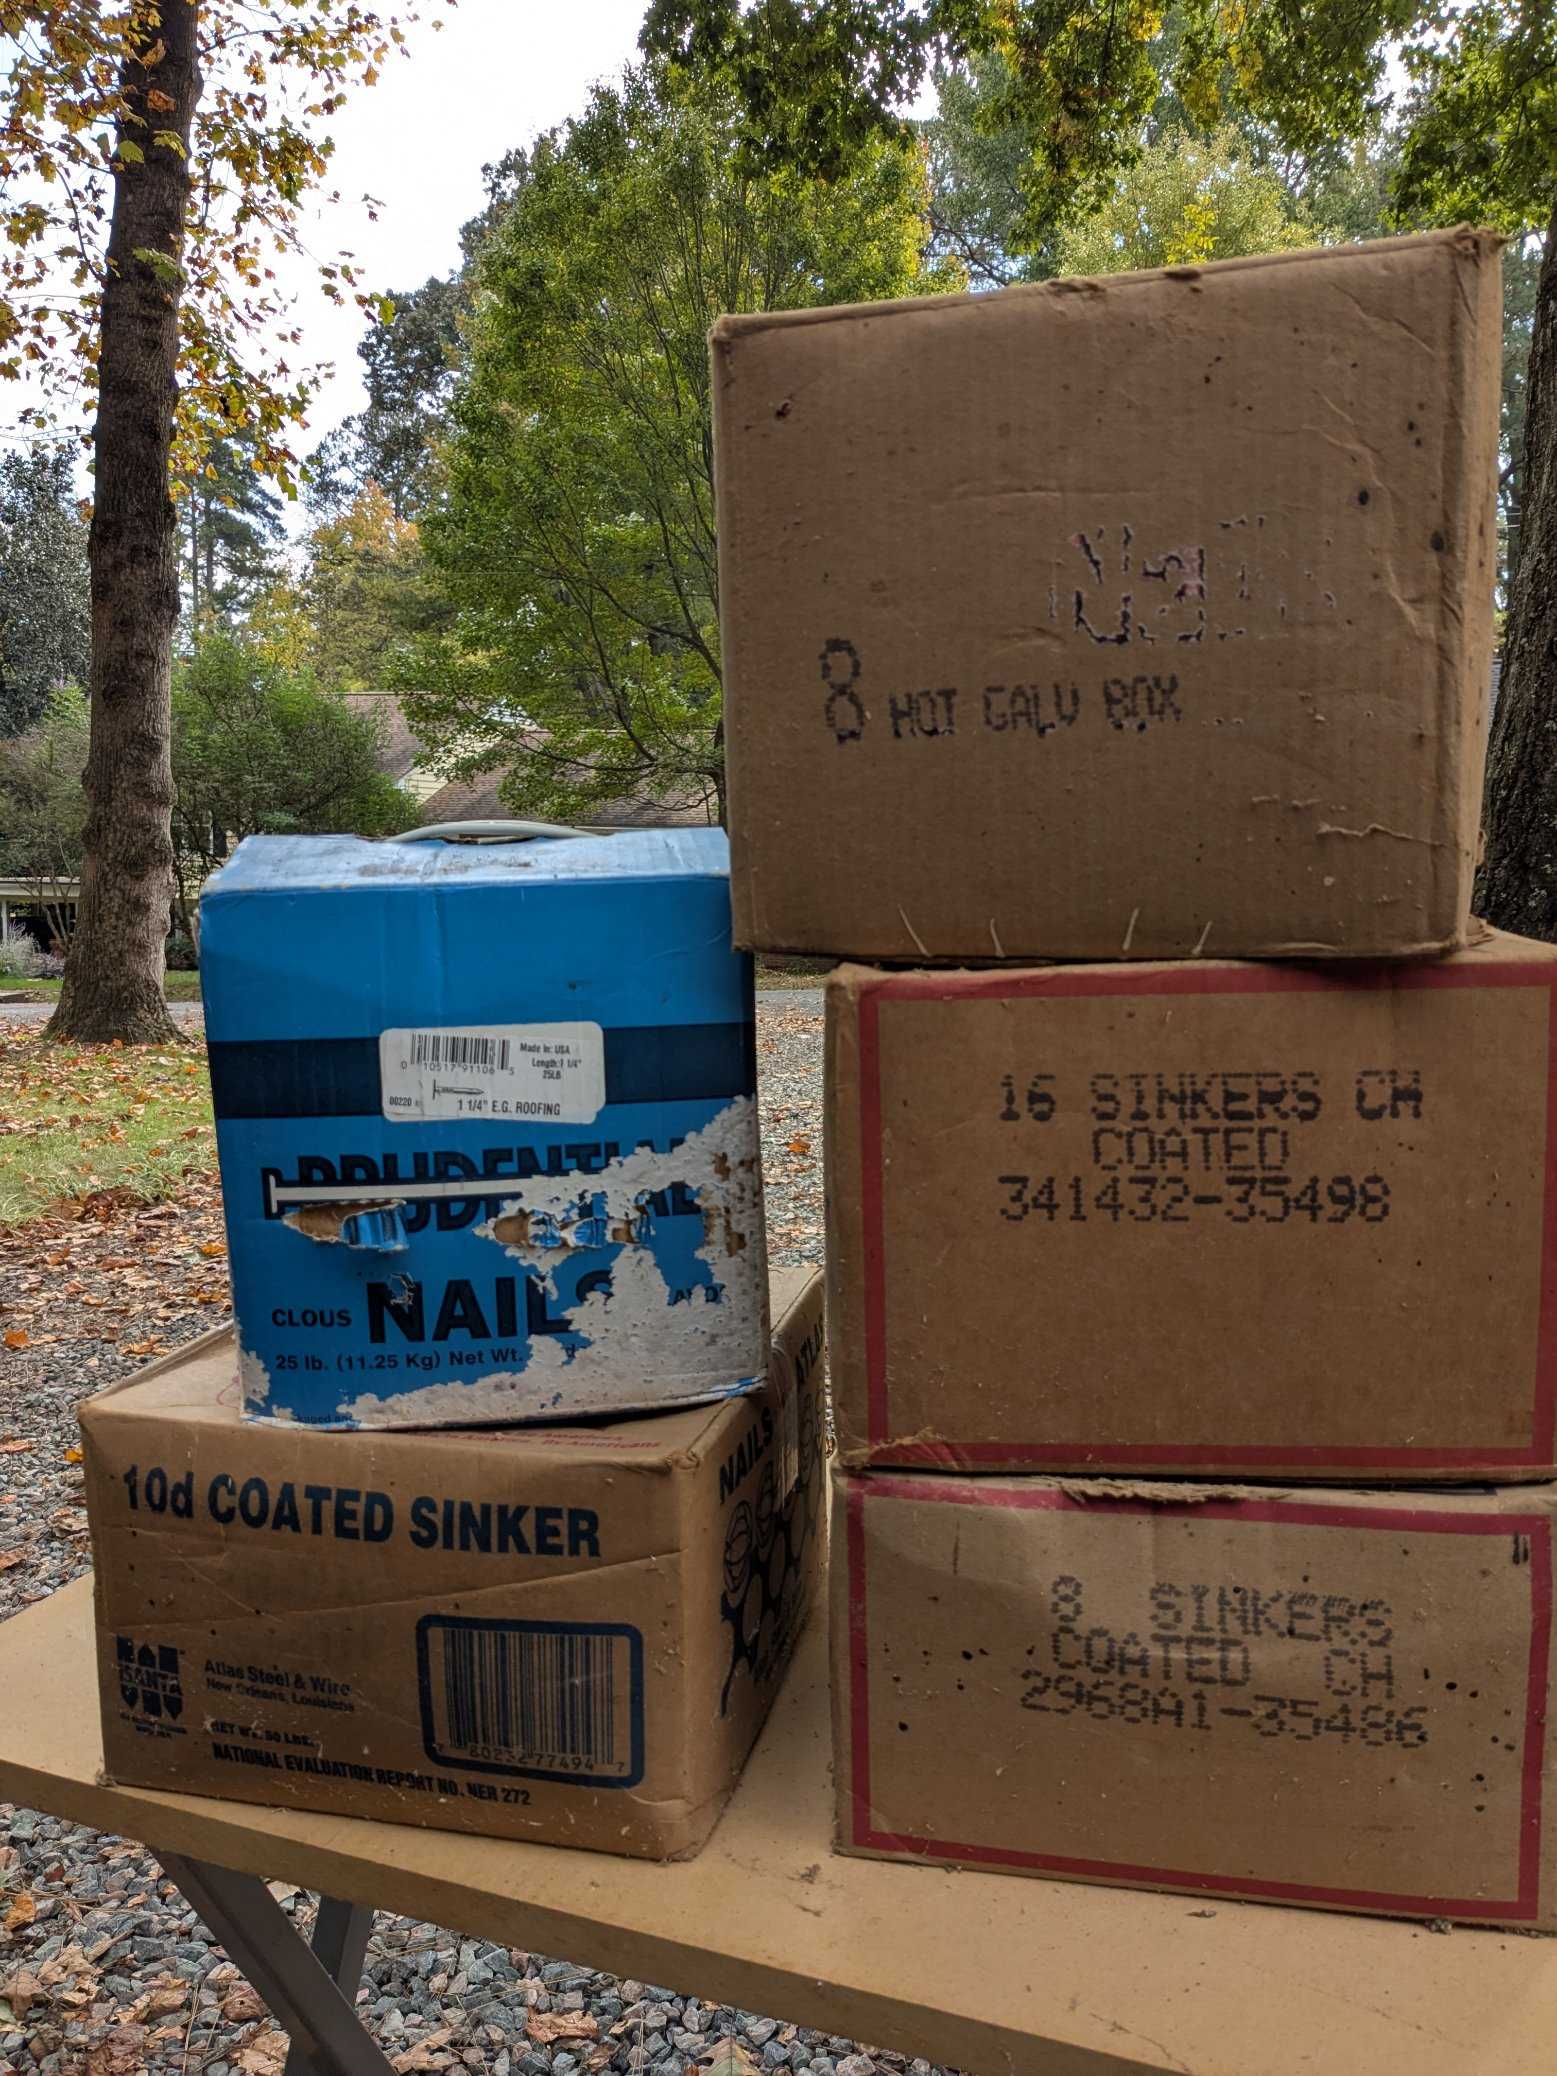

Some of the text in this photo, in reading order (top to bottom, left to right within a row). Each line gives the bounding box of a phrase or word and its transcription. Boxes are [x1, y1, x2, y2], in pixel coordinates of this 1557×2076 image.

[819, 637, 1183, 744] 8 HOT GALV BOX
[520, 1043, 541, 1052] Made
[492, 1101, 512, 1114] E.G.
[516, 1102, 560, 1116] ROOFING
[1000, 1074, 1056, 1121] 16
[1091, 1072, 1322, 1122] SINKERS
[1092, 1127, 1290, 1171] COATED
[999, 1175, 1391, 1223] 341432-35498
[271, 1308, 352, 1328] CLOUS
[275, 1346, 523, 1372] 25 lb. (11.25 Kg) Net Wt.
[720, 1407, 773, 1504] NAILS
[123, 1464, 601, 1558] 10d COATED SINKER
[1050, 1574, 1395, 1648] 8 SINKERS
[204, 1659, 244, 1680] Atlas
[248, 1665, 289, 1688] Steel
[309, 1674, 353, 1697] Wire
[1051, 1624, 1251, 1688] COATED
[212, 1741, 283, 1770] NATIONAL
[284, 1753, 375, 1784] EVALUATION
[376, 1768, 434, 1793] REPORT
[501, 1786, 532, 1806] 272
